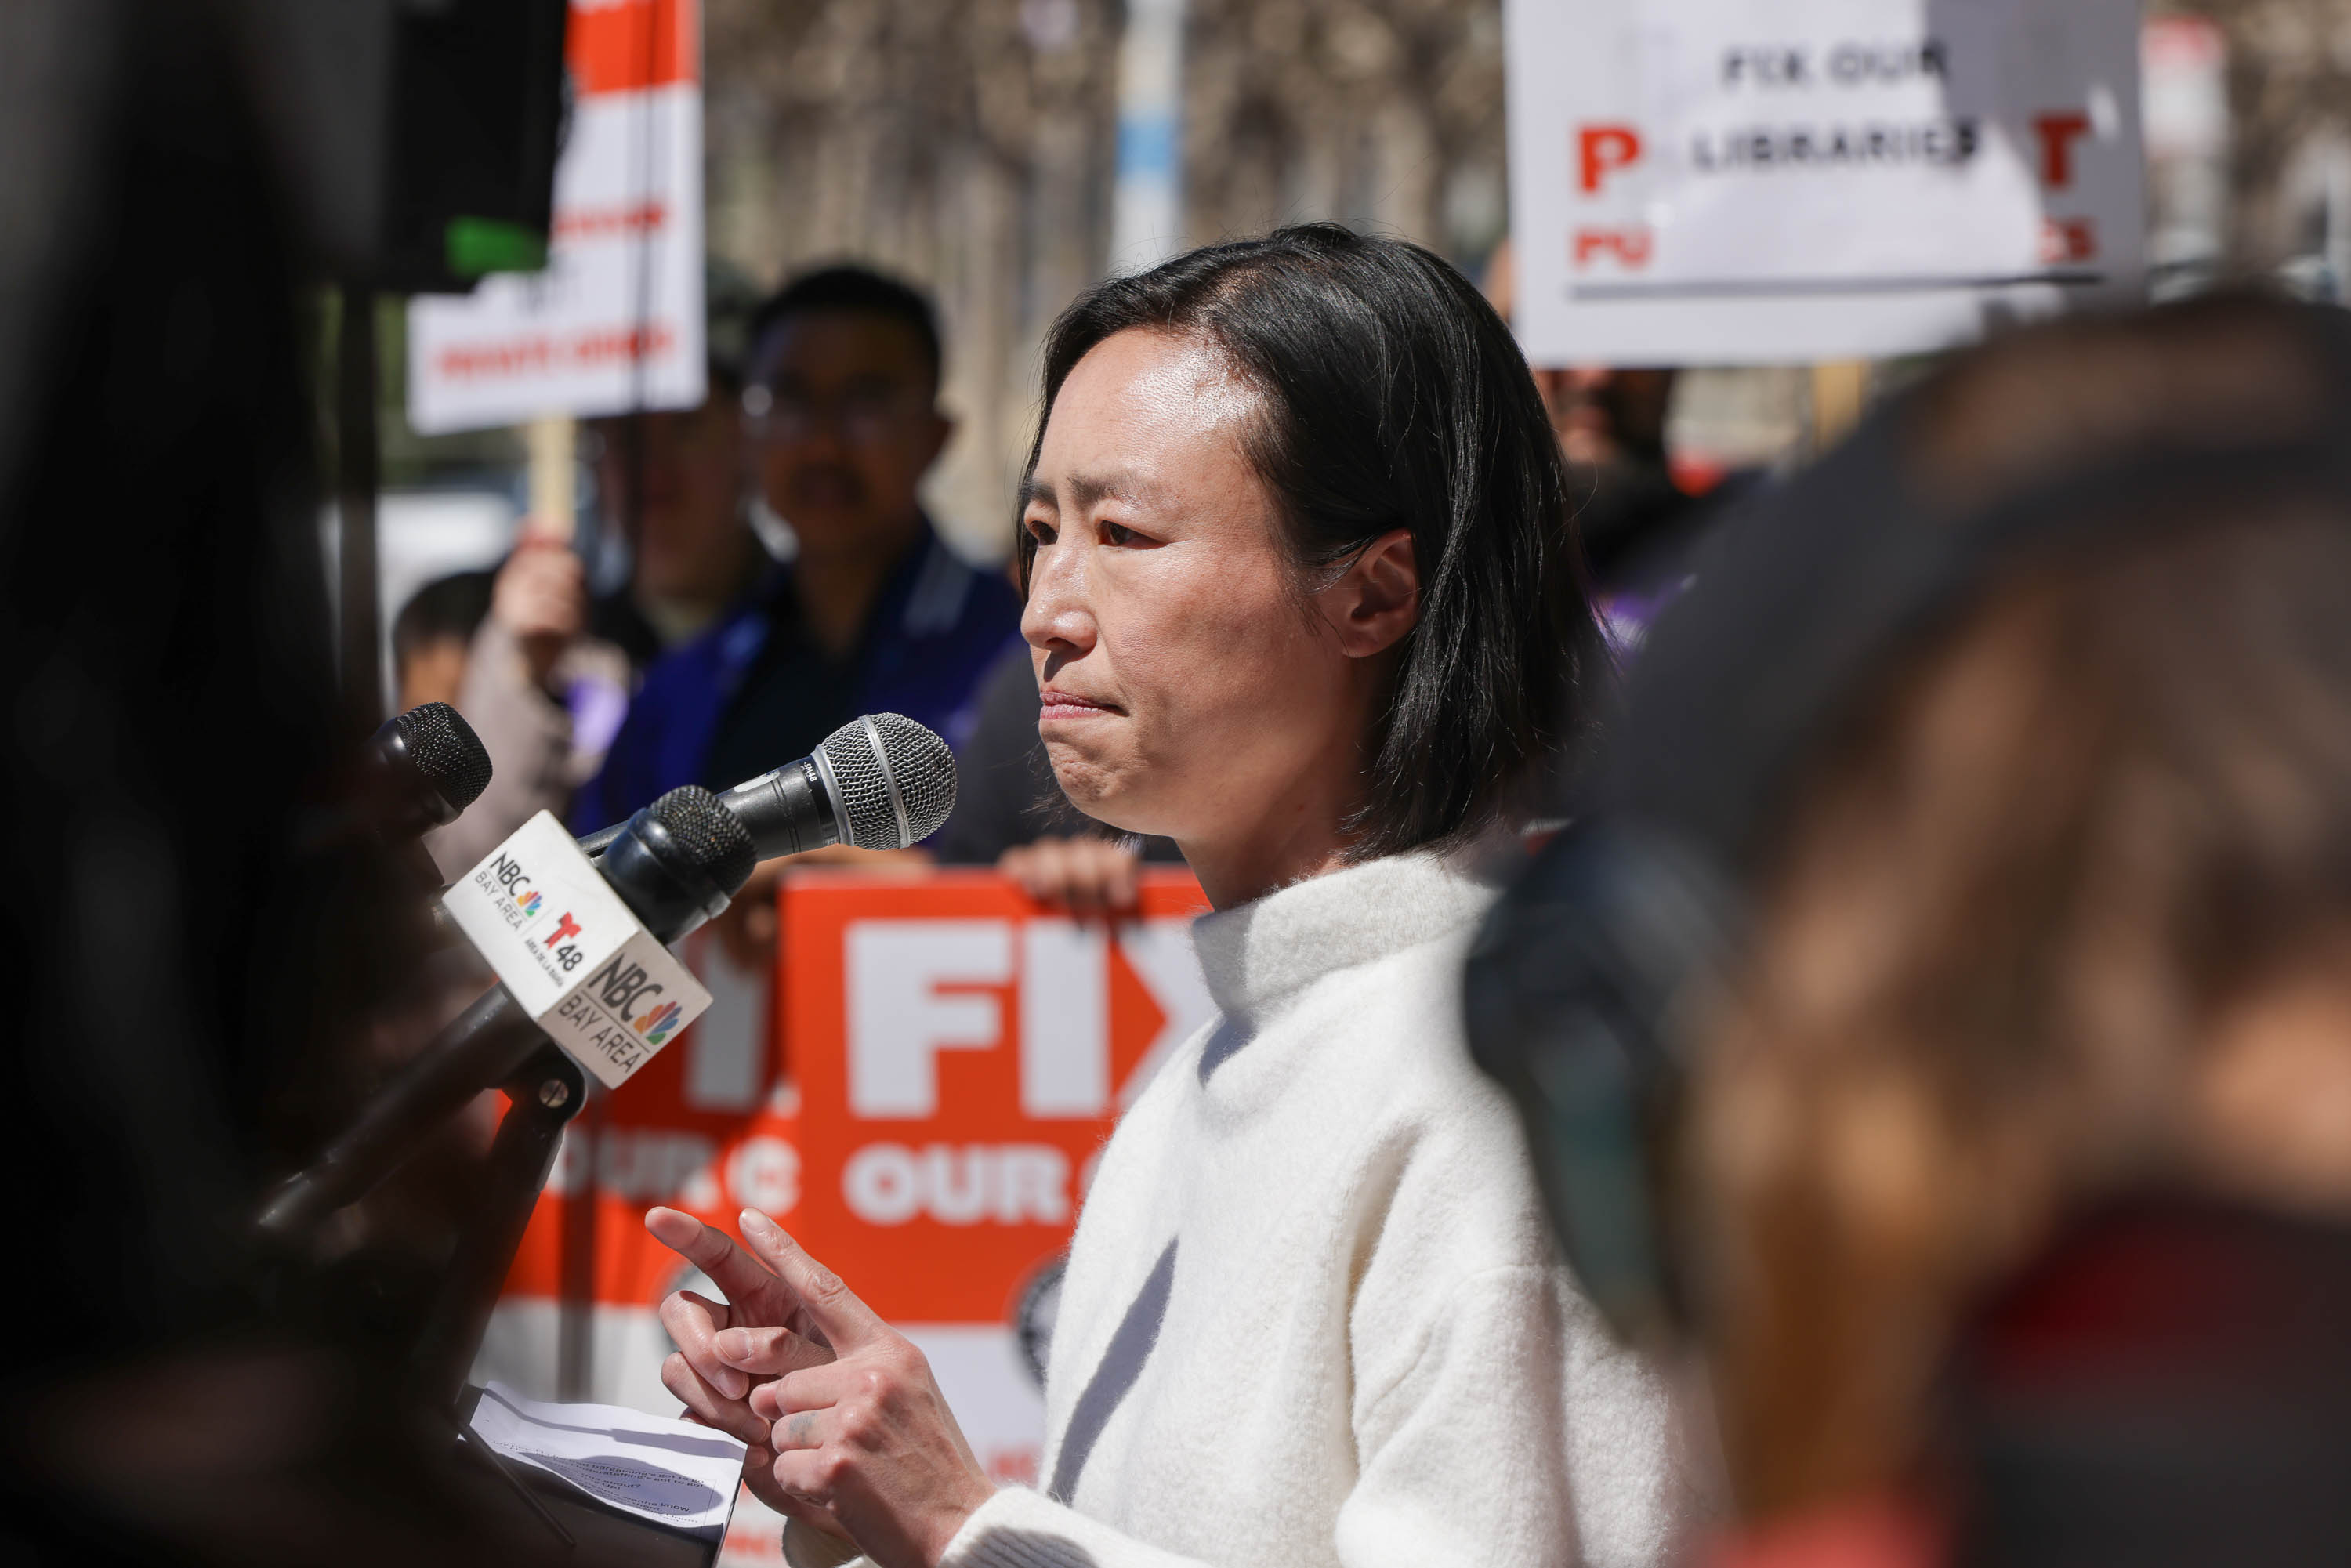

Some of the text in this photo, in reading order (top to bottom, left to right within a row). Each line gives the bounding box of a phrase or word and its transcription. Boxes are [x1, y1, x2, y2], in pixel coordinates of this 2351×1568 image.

[1721, 39, 1951, 89] FIX OUR
[1691, 116, 1980, 172] LIBRARIES
[803, 762, 817, 782] SM48
[475, 871, 523, 931] BAY AREA
[490, 852, 530, 896] NBC
[557, 944, 583, 971] 48
[588, 954, 664, 1023] NBC
[558, 994, 643, 1074] BAY AREA
[841, 1144, 1072, 1227] OUR
